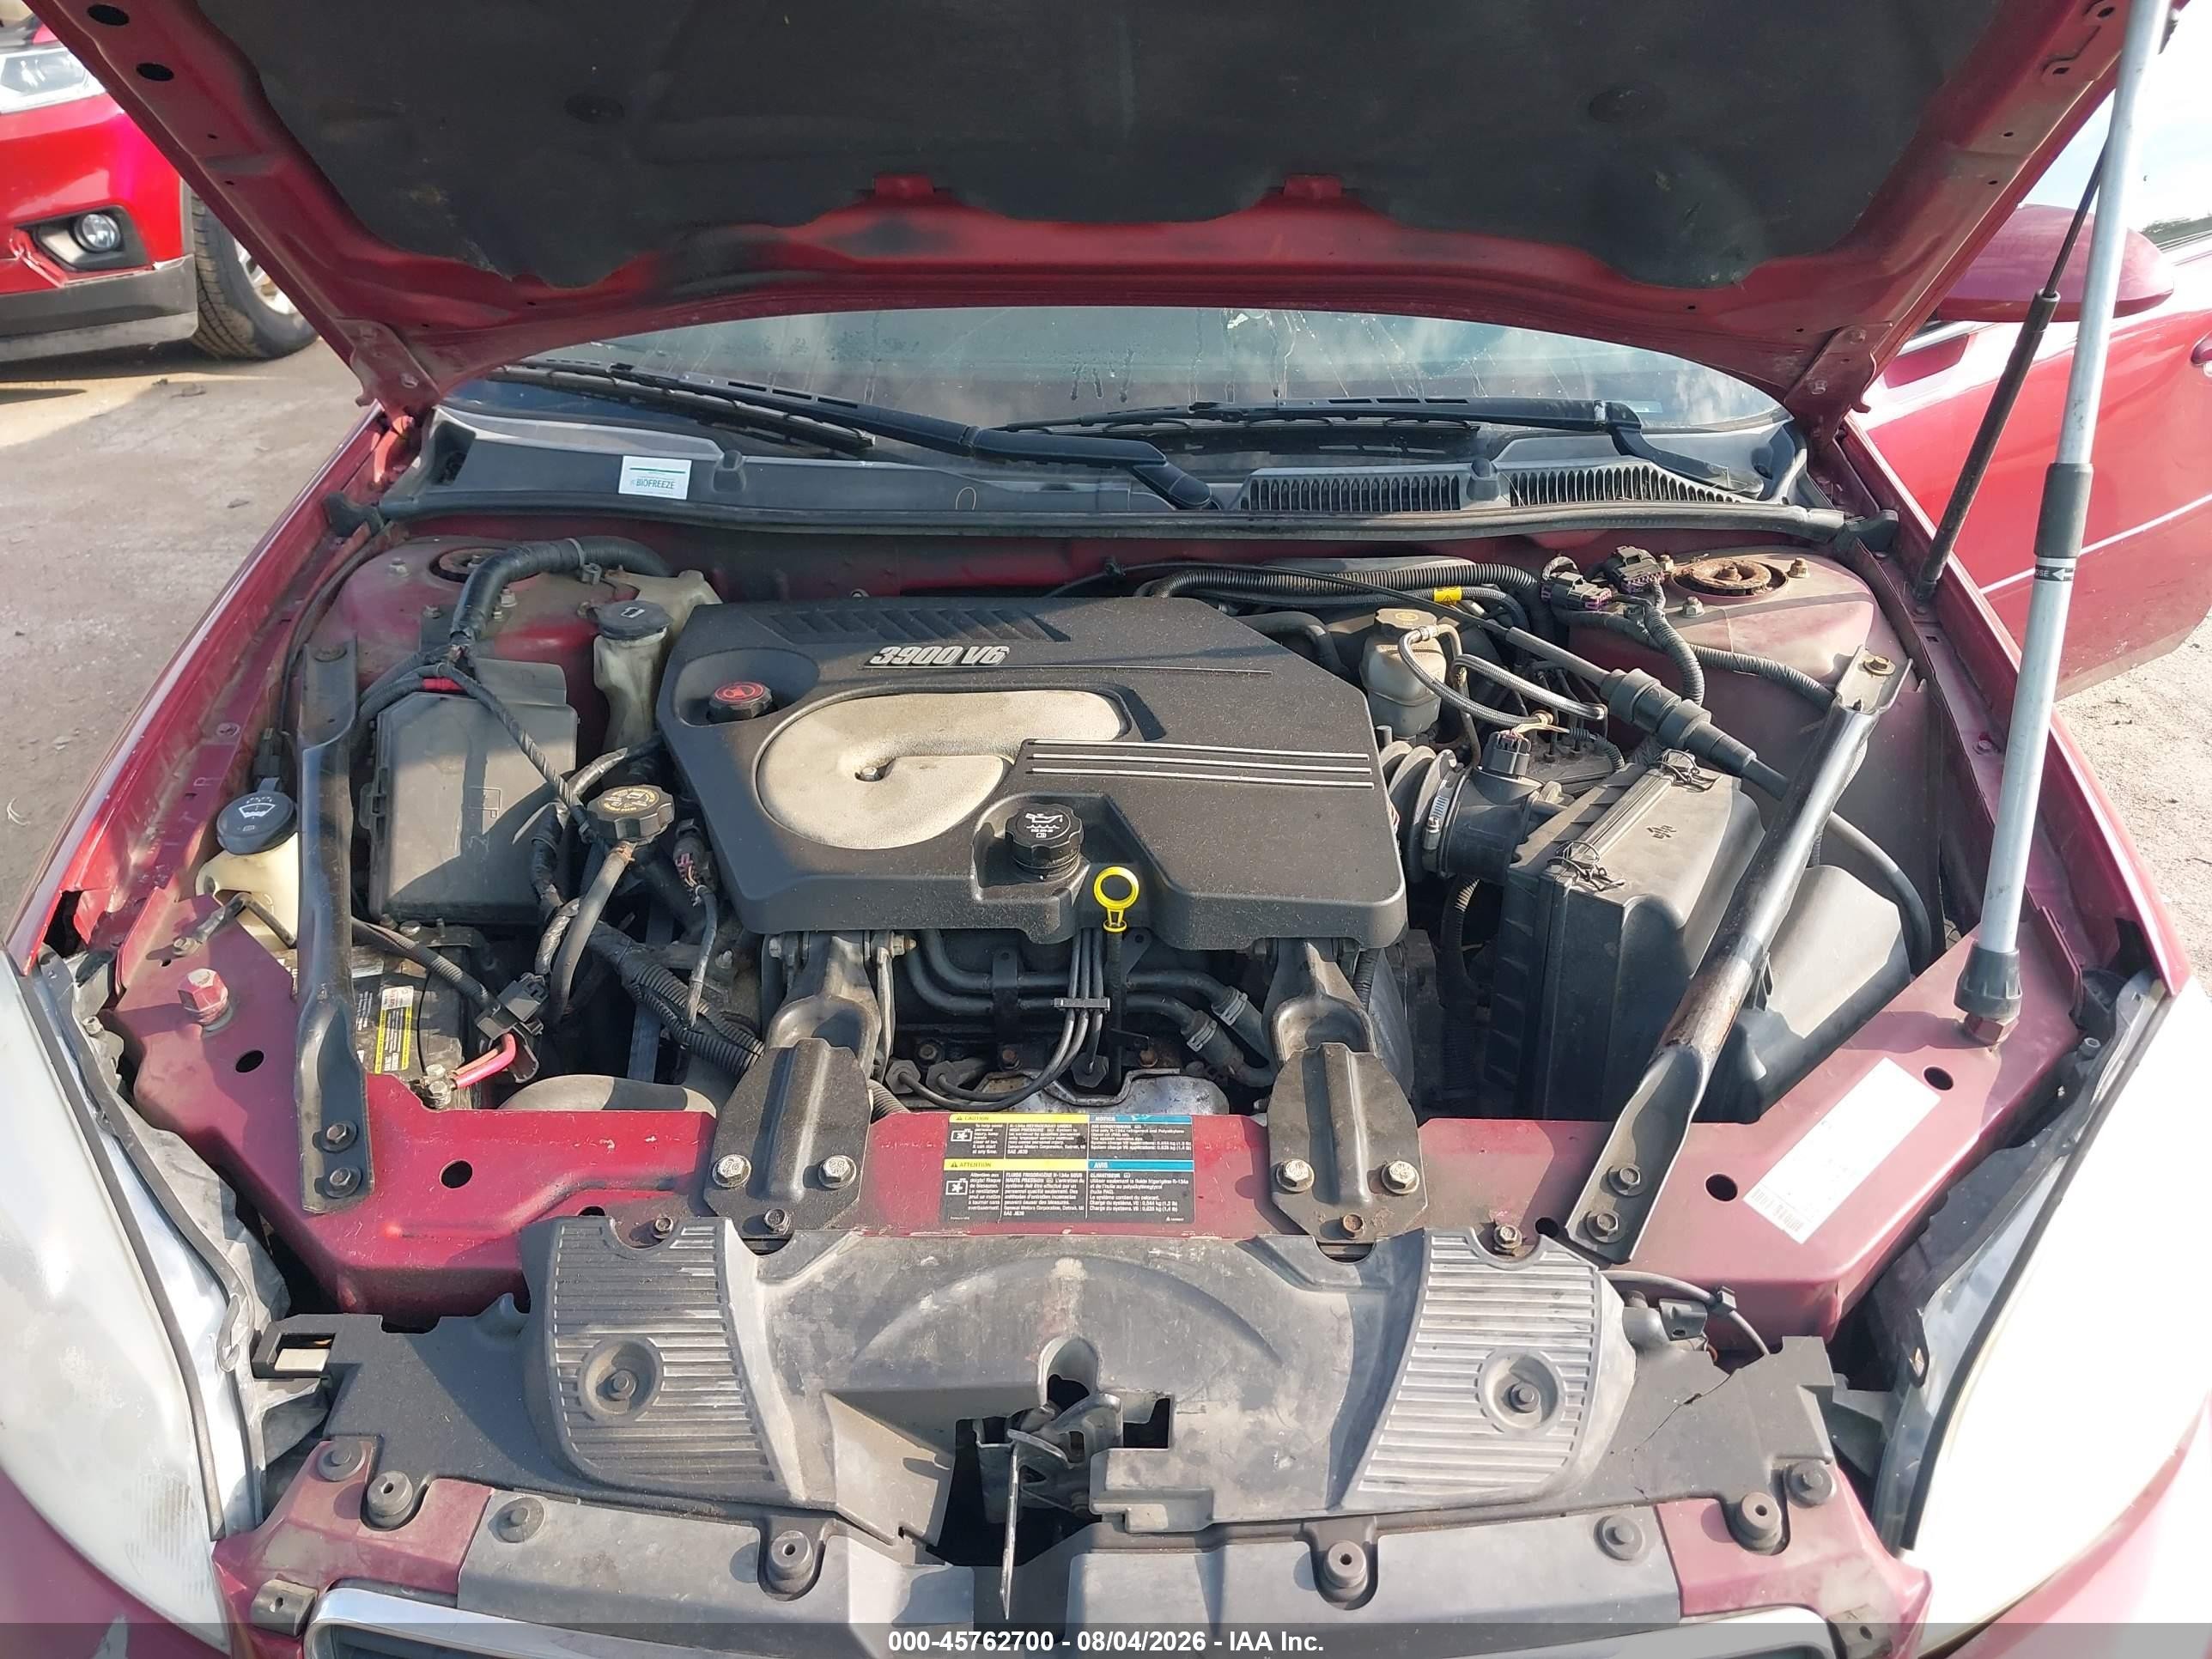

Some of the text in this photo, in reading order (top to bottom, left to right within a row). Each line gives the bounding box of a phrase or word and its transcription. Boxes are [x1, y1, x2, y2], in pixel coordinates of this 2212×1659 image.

[636, 477, 676, 489] BIOFREEZE
[869, 645, 1011, 666] 3900 V6
